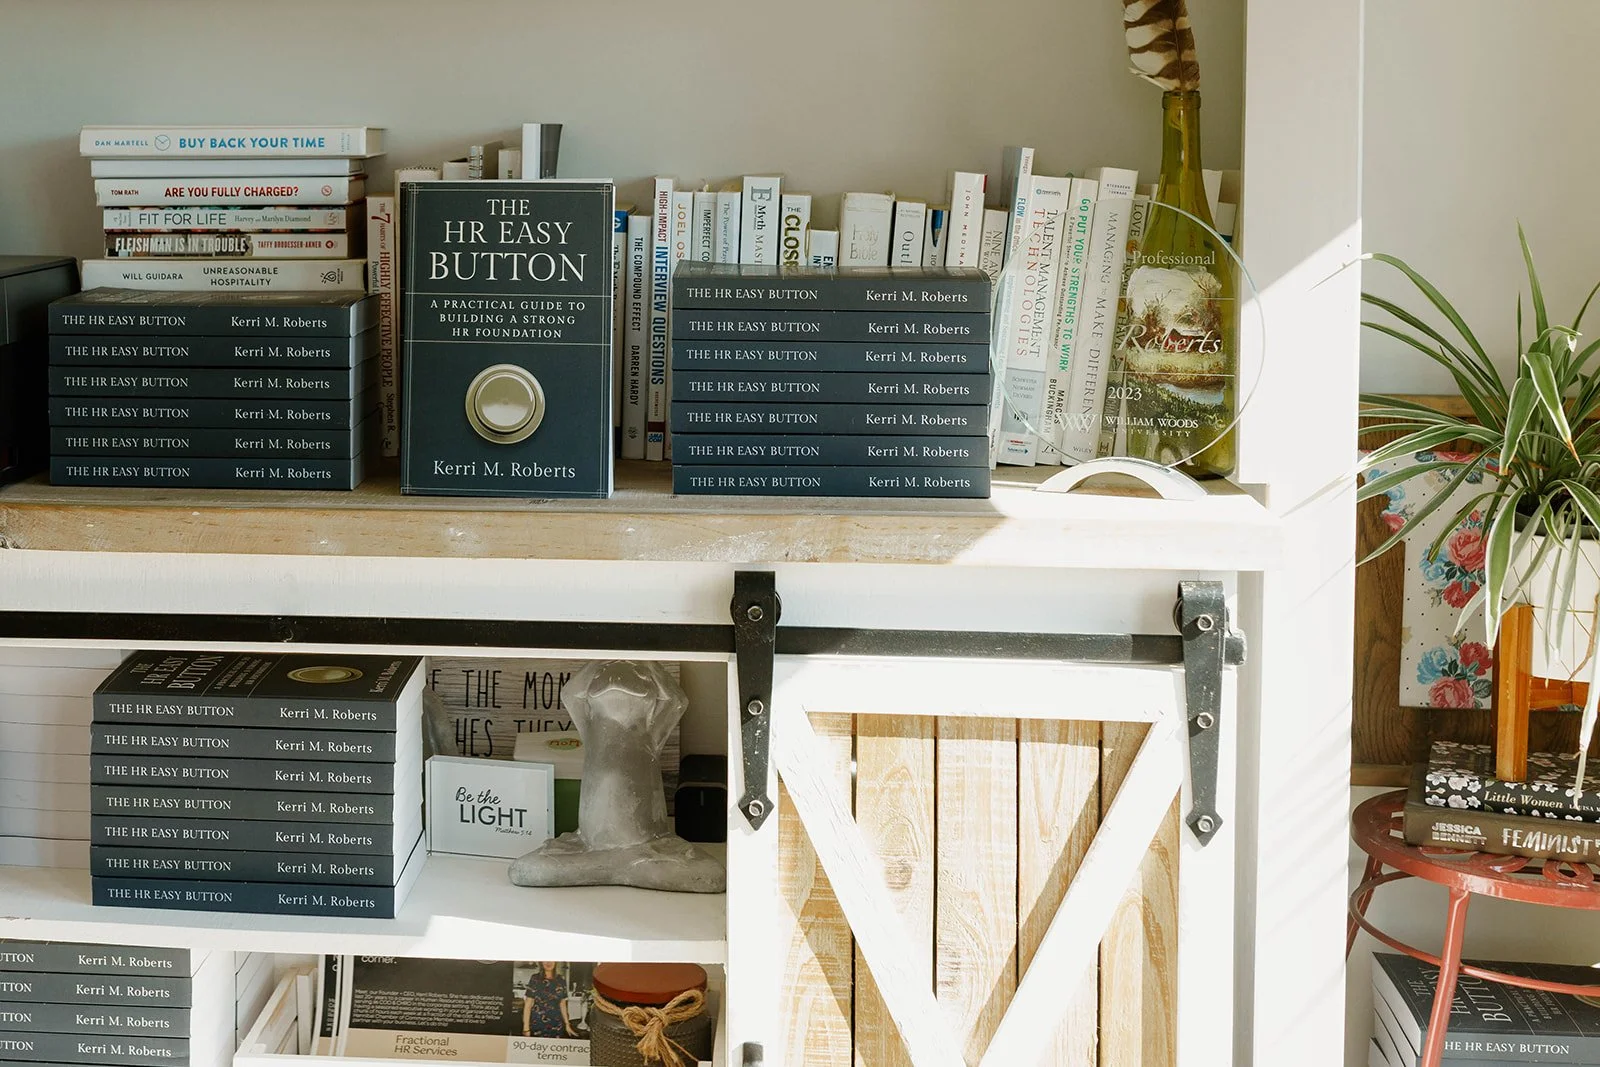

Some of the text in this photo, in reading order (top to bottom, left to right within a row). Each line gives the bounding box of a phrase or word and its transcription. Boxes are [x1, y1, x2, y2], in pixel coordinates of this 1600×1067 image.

[180, 138, 324, 148] BUY BACK YOUR TIME
[165, 187, 298, 197] ARE YOU FULLY CHARGED?
[487, 199, 530, 215] THE
[1016, 197, 1026, 217] FLOW
[1080, 198, 1091, 212] GO
[140, 213, 226, 225] FIT FOR LIFE
[371, 212, 390, 224] 7
[657, 190, 669, 243] HIGH-IMPACT
[677, 203, 687, 237] JOEL
[755, 204, 767, 230] Myth
[1131, 203, 1144, 237] LOVE
[445, 221, 572, 244] HR EASY
[703, 209, 712, 249] IMPERFECT
[958, 189, 972, 266] JOHN MEDINA
[1076, 214, 1089, 236] PUT
[1041, 209, 1059, 259] TALENT
[115, 237, 246, 253] FLEISHMAN IS IN TROUBLE
[989, 230, 1003, 257] NINE
[1132, 250, 1216, 266] Professional
[203, 266, 279, 275] UNREASONABLE
[371, 260, 380, 288] Powerful
[379, 251, 392, 289] HIGHLY
[429, 252, 587, 281] BUTTON
[123, 272, 183, 281] WILL GUIDARA
[211, 278, 272, 287] HOSPITALITY
[654, 246, 669, 313] INTERVIEW
[1015, 208, 1047, 357] TECHNOLOGIES
[687, 288, 817, 299] THE HR EASY BUTTON
[867, 291, 967, 302] Kerri M. Roberts
[1064, 267, 1081, 326] STRENGTHS
[431, 300, 587, 311] A PRACTICAL GUIDE TO
[1029, 262, 1051, 358] MANAGEMENT
[62, 315, 185, 326] THE HR EASY BUTTON
[232, 317, 327, 327] Kerri M. Roberts
[380, 292, 393, 346] EFFECTIVE
[440, 314, 575, 324] BUILDING A STRONG
[629, 237, 644, 406] THE COMPOUND EFFECT DARREN HARDY
[1091, 297, 1104, 339] MAKE
[453, 328, 561, 338] HR FOUNDATION
[1118, 323, 1222, 354] Roberts
[651, 317, 665, 385] QUESTIONS
[1058, 343, 1071, 373] WORK
[381, 348, 393, 387] PEOPLE
[1107, 387, 1143, 401] 2023
[385, 393, 396, 424] Stephen
[1043, 378, 1058, 435] BUCKINGHAM
[1105, 416, 1155, 427] WILLIAM
[1157, 417, 1199, 429] WOODS
[434, 461, 575, 478] Kerri M. Roberts
[462, 669, 503, 709] THE
[109, 704, 233, 716] THE HR EASY BUTTON
[280, 708, 376, 720] Kerri M. Roberts
[456, 786, 501, 805] Be the
[1484, 790, 1517, 805] Little
[1519, 794, 1564, 809] Women
[460, 803, 528, 828] LIGHT
[1431, 822, 1482, 836] JESSICA
[1432, 831, 1487, 845] BENNETT
[1501, 828, 1594, 856] FEMINIST
[107, 889, 232, 902] THE HR EASY BUTTON
[279, 894, 375, 907] Kerri M. Roberts
[79, 955, 172, 968] Kerri M. Roberts
[76, 1015, 169, 1028] Kerri M. Roberts
[395, 1034, 450, 1047] Fractional
[512, 1040, 549, 1054] 90-day
[1466, 1041, 1483, 1052] HR
[1487, 1042, 1516, 1054] EASY
[1520, 1043, 1570, 1056] BUTTON
[394, 1044, 458, 1057] HR Services
[537, 1052, 568, 1062] terms
